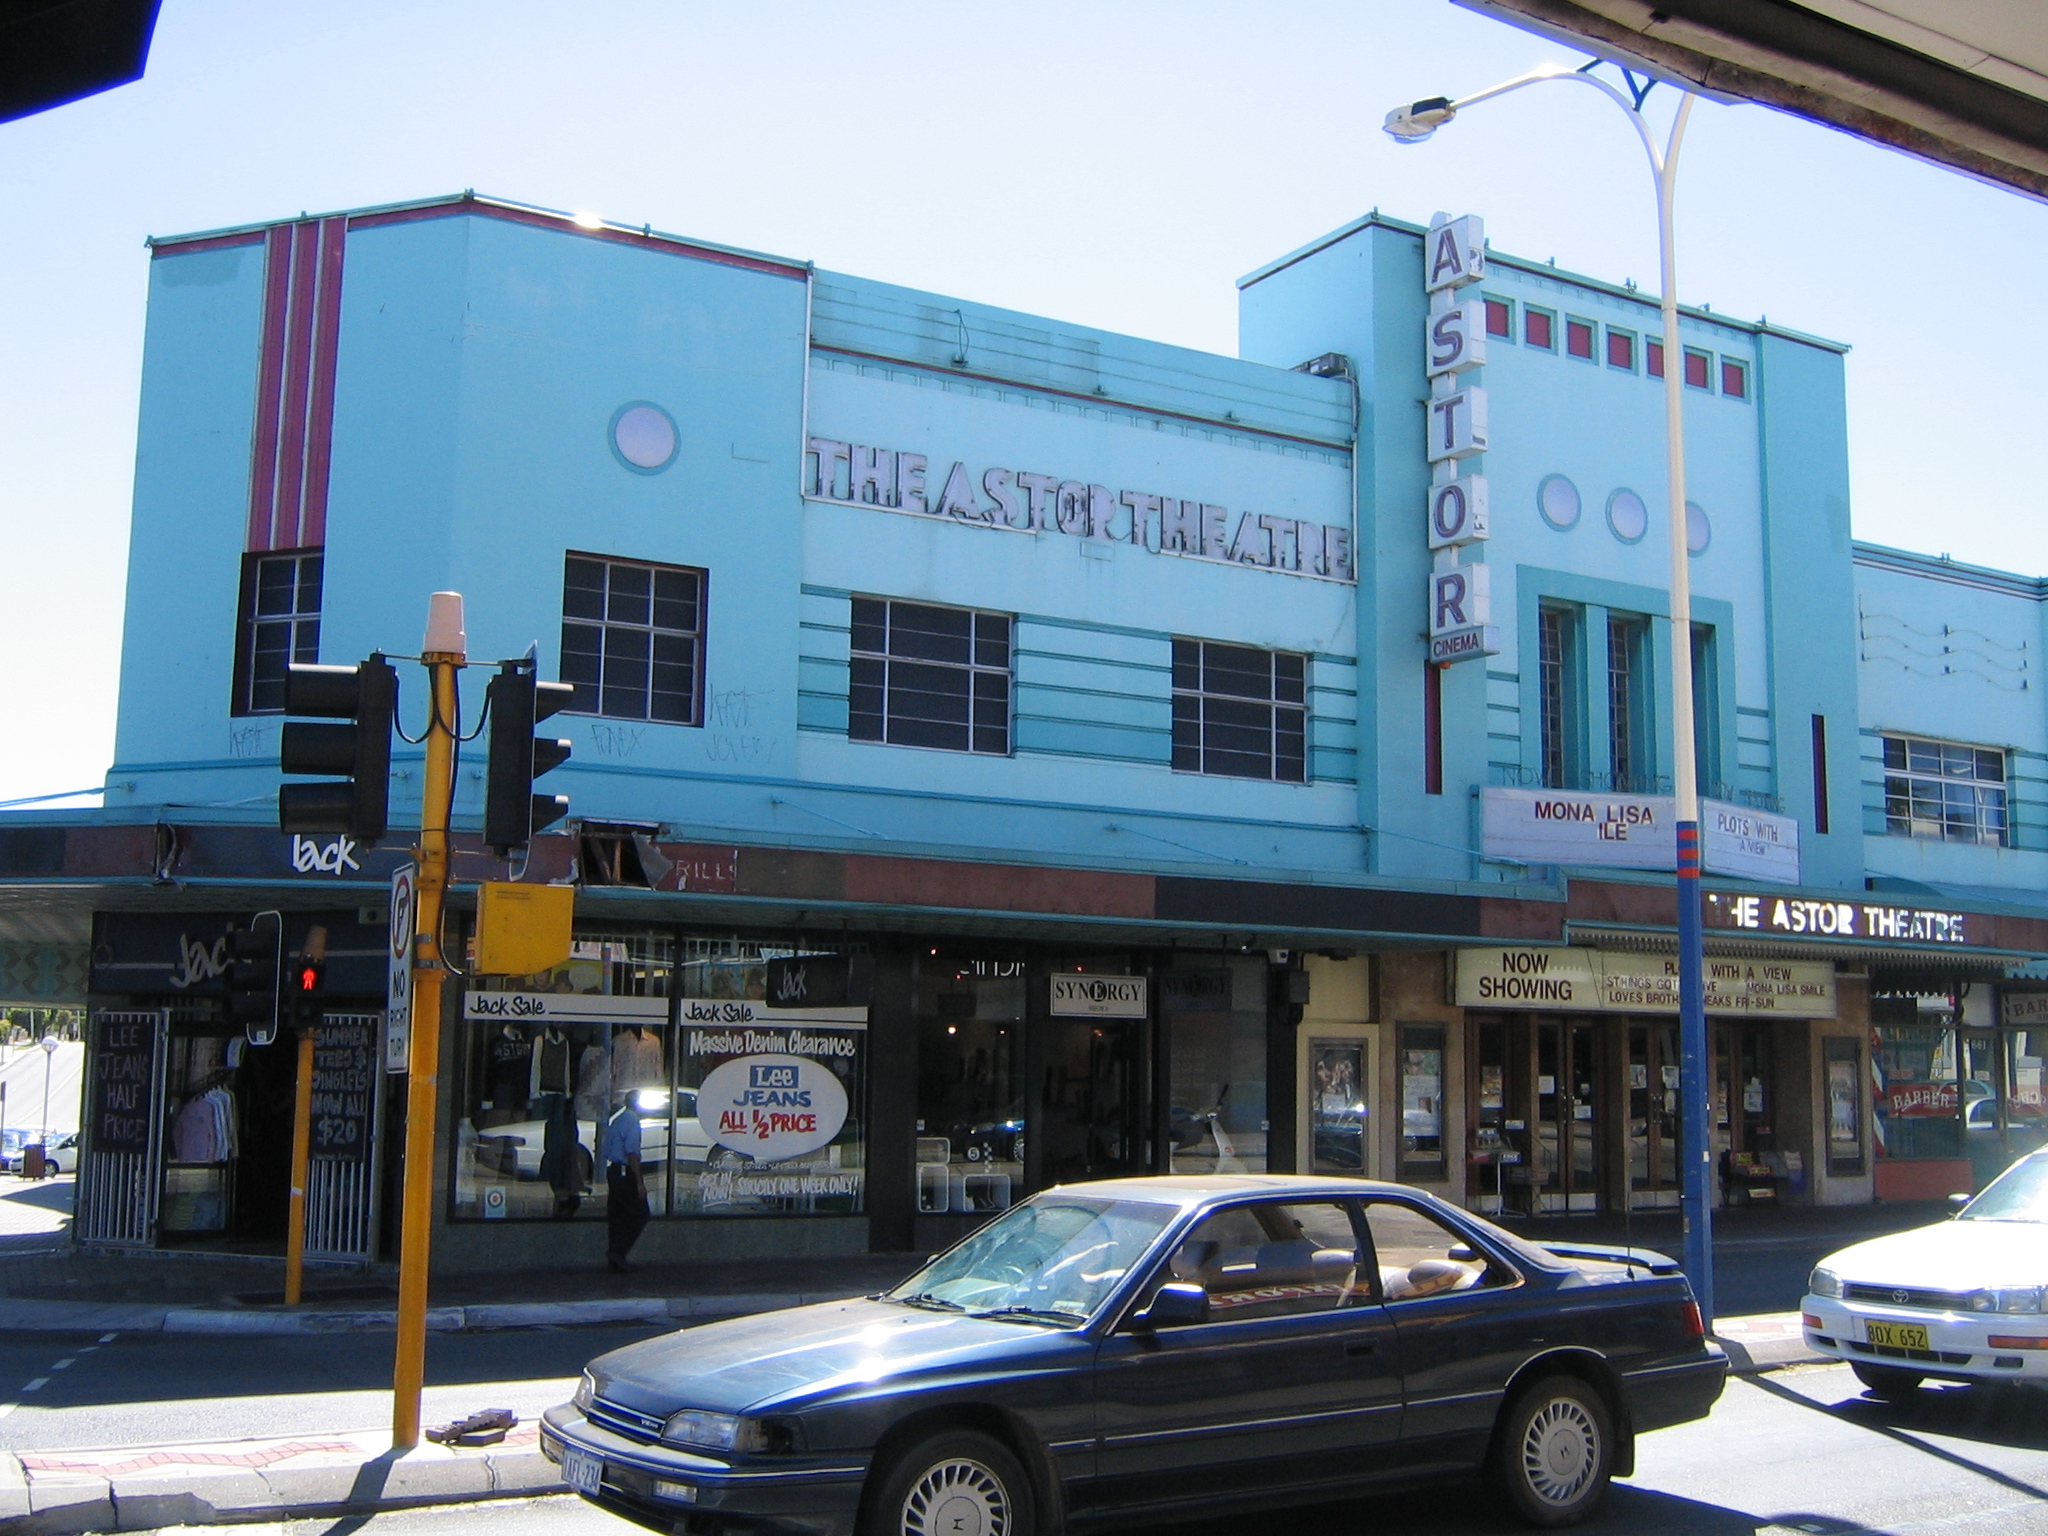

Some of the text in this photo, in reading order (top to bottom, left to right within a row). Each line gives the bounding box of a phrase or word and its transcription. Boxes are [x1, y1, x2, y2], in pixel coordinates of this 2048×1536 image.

[1431, 228, 1467, 628] ASTOR
[807, 436, 1353, 581] THE ASTOR THEATRE
[1433, 632, 1479, 657] CINEMA
[1535, 801, 1654, 824] MONA LISA
[1599, 823, 1627, 841] ILE
[1718, 814, 1779, 842] PLOTS WITH
[1708, 894, 1965, 942] THE ASTOR THEATRE
[169, 922, 242, 988] Jac
[1503, 953, 1549, 974] NOW
[777, 964, 807, 1000] Jack
[1711, 964, 1740, 978] WITH
[1747, 966, 1755, 979] A
[1763, 966, 1791, 981] VIEW
[393, 969, 406, 999] NO
[1055, 980, 1142, 1002] SYNERGY
[1479, 976, 1572, 1001] SHOWING
[1748, 982, 1773, 994] MONA
[1777, 984, 1797, 995] LISA
[470, 995, 545, 1016] Jack Sale
[1609, 991, 1643, 1003] LOVES
[685, 1002, 754, 1022] Jack Sale
[110, 1026, 141, 1047] LEE
[314, 1026, 369, 1048] SUMMER
[689, 1029, 856, 1056] Massive Denim Clearance
[100, 1052, 149, 1084] JEANS
[755, 1067, 794, 1087] Lee
[107, 1083, 140, 1110] HALF
[312, 1093, 343, 1115] NOW
[733, 1091, 811, 1107] JEANS
[1893, 1090, 1950, 1110] BARBER
[104, 1113, 146, 1142] PRICE
[317, 1115, 357, 1146] $20
[719, 1111, 747, 1130] ALL
[770, 1113, 817, 1132] PRICE
[737, 1176, 859, 1196] STRICTLY ONE WEEK ONLY!
